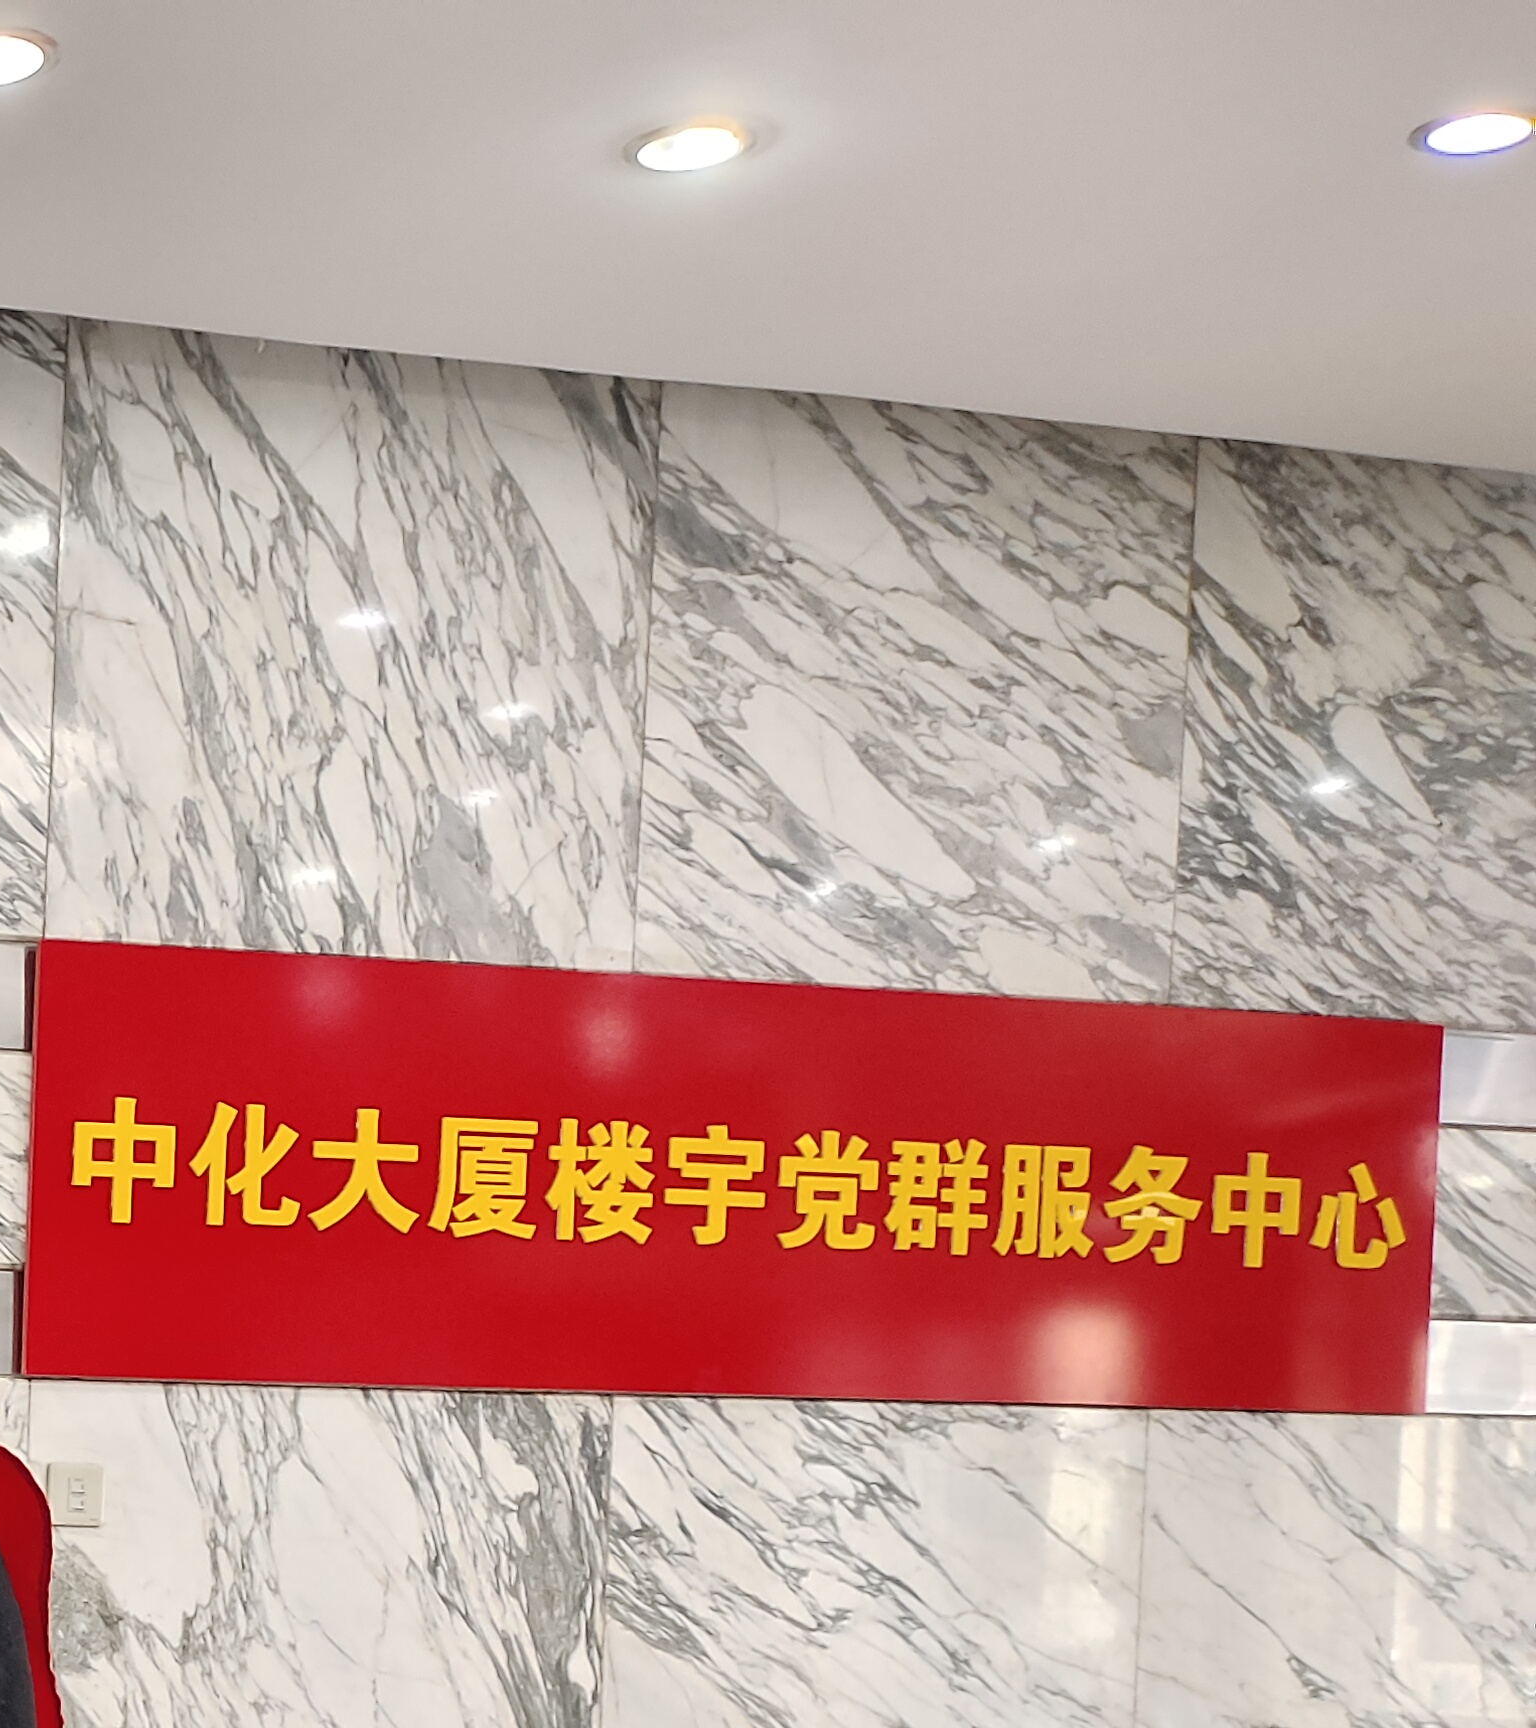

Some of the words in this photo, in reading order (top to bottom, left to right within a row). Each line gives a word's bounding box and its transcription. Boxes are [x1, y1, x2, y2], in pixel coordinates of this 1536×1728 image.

[69, 1095, 1407, 1272] 中化大厦楼宇党群服务中心
